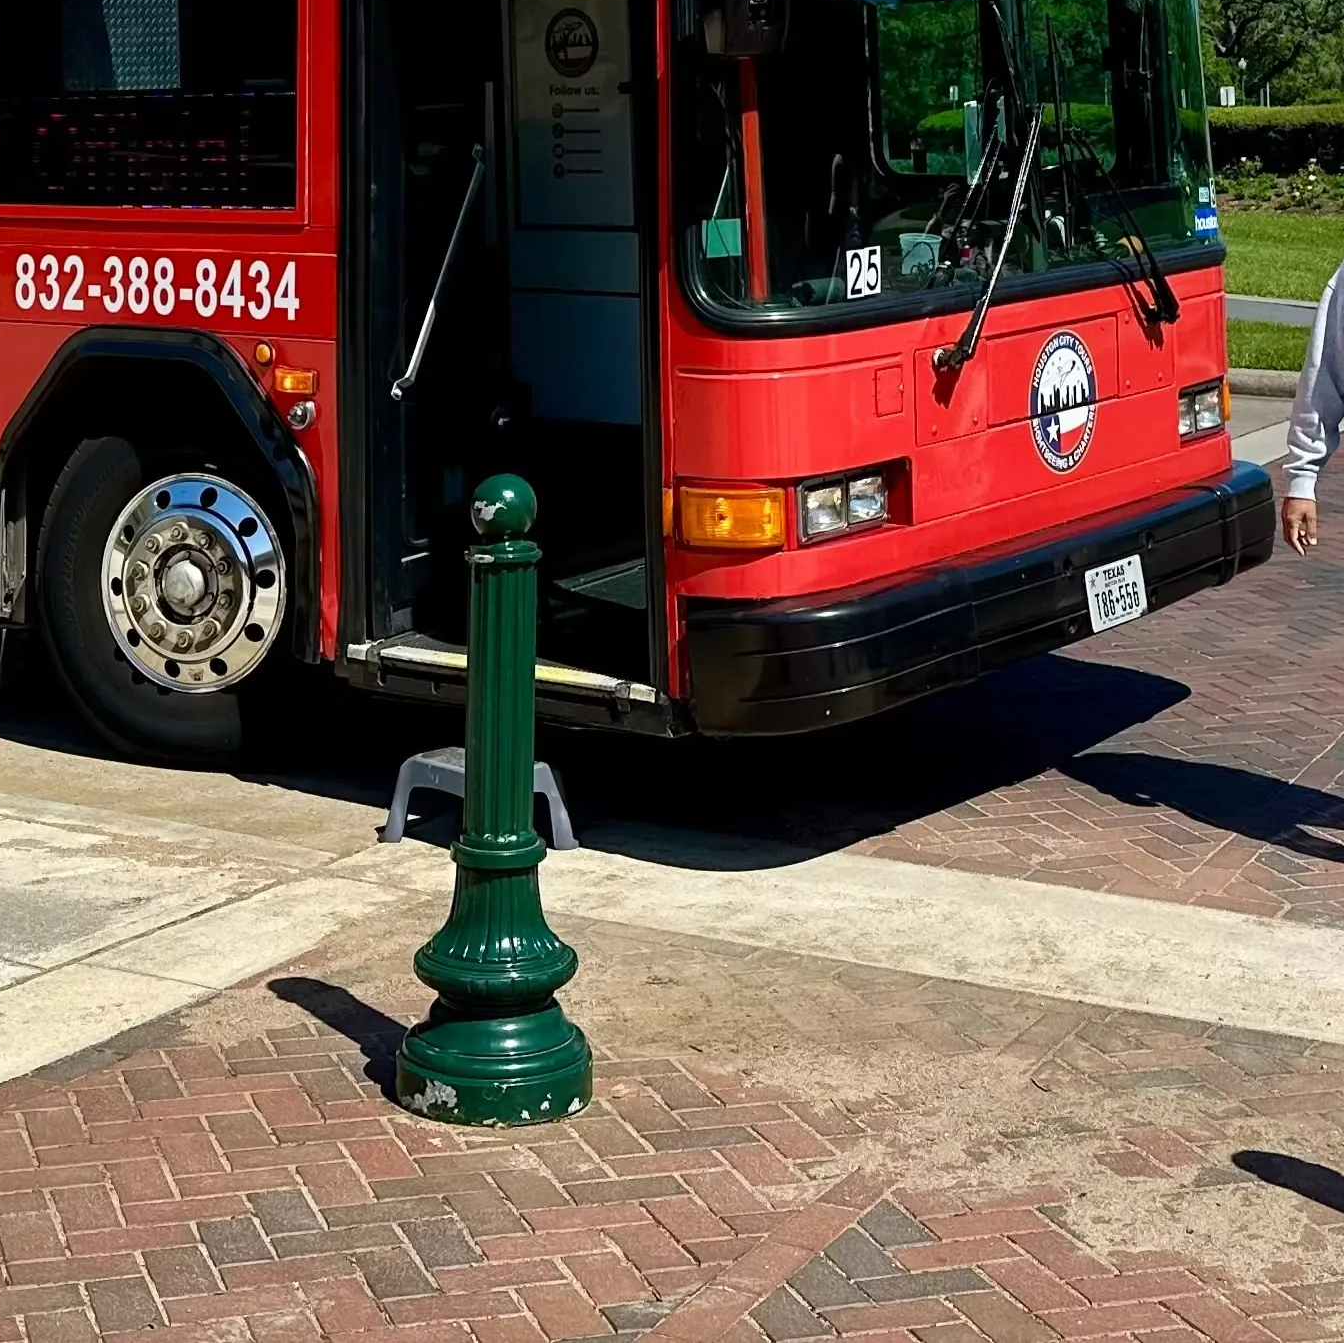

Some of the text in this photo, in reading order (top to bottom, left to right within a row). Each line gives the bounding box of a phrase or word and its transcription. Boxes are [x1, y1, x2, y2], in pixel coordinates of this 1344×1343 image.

[15, 253, 300, 321] 832-388-8434
[849, 248, 879, 296] 25
[1032, 335, 1093, 388] HOUSTON CITY TOURS
[1102, 564, 1125, 581] TEXAS
